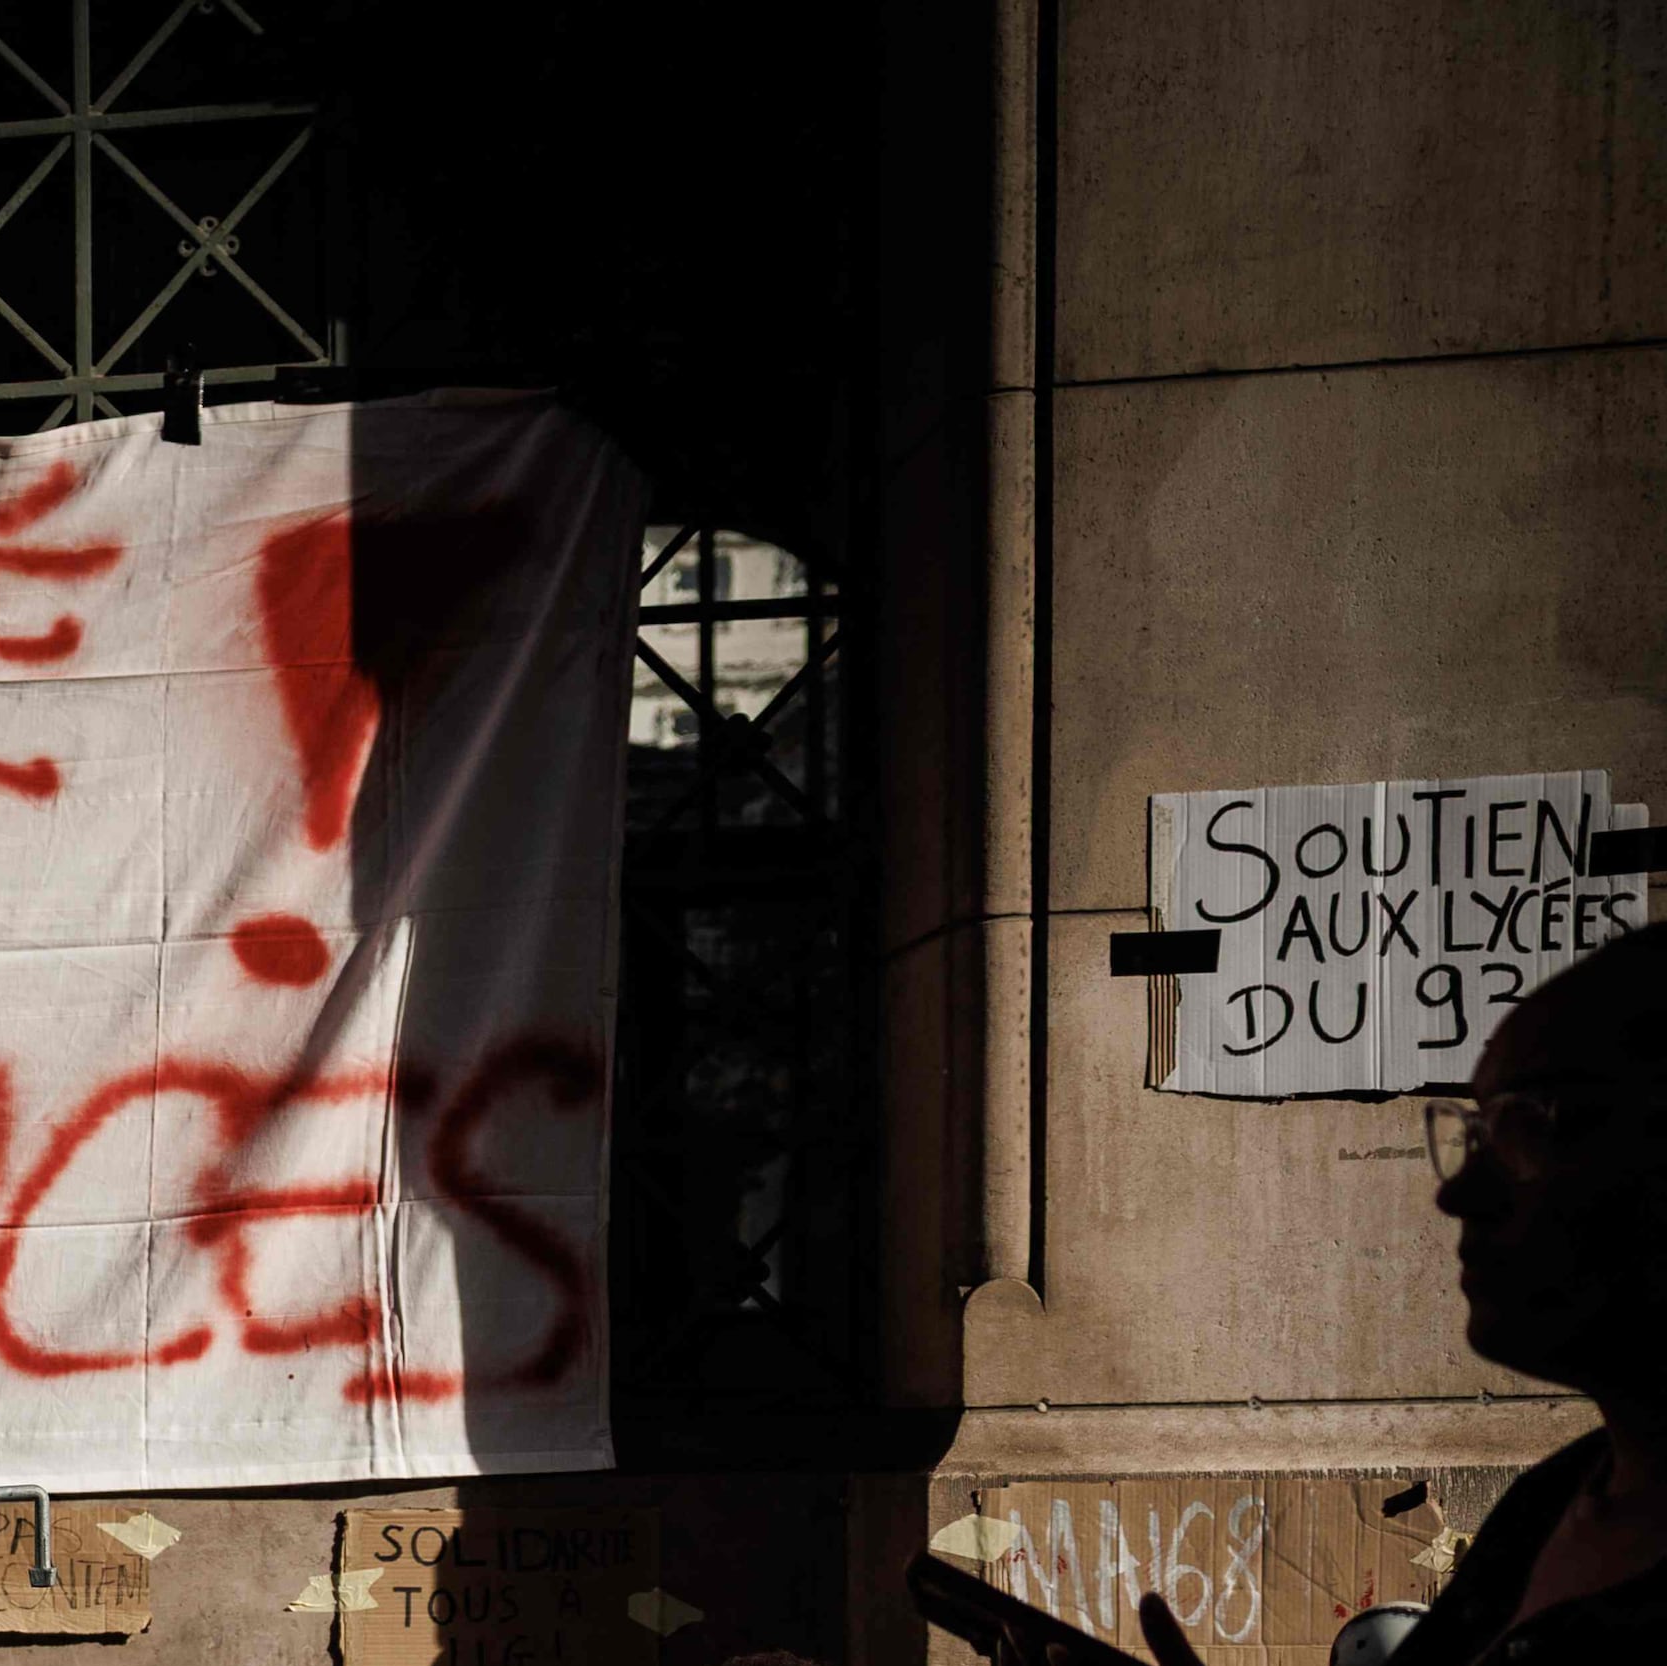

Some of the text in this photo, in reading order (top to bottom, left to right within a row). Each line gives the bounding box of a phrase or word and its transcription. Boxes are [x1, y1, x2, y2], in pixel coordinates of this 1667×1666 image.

[1197, 791, 1592, 923] SOUTIEN
[1277, 878, 1636, 963] AUX LYCÉES
[1223, 980, 1366, 1056] DU
[393, 1586, 519, 1627] TOUS
